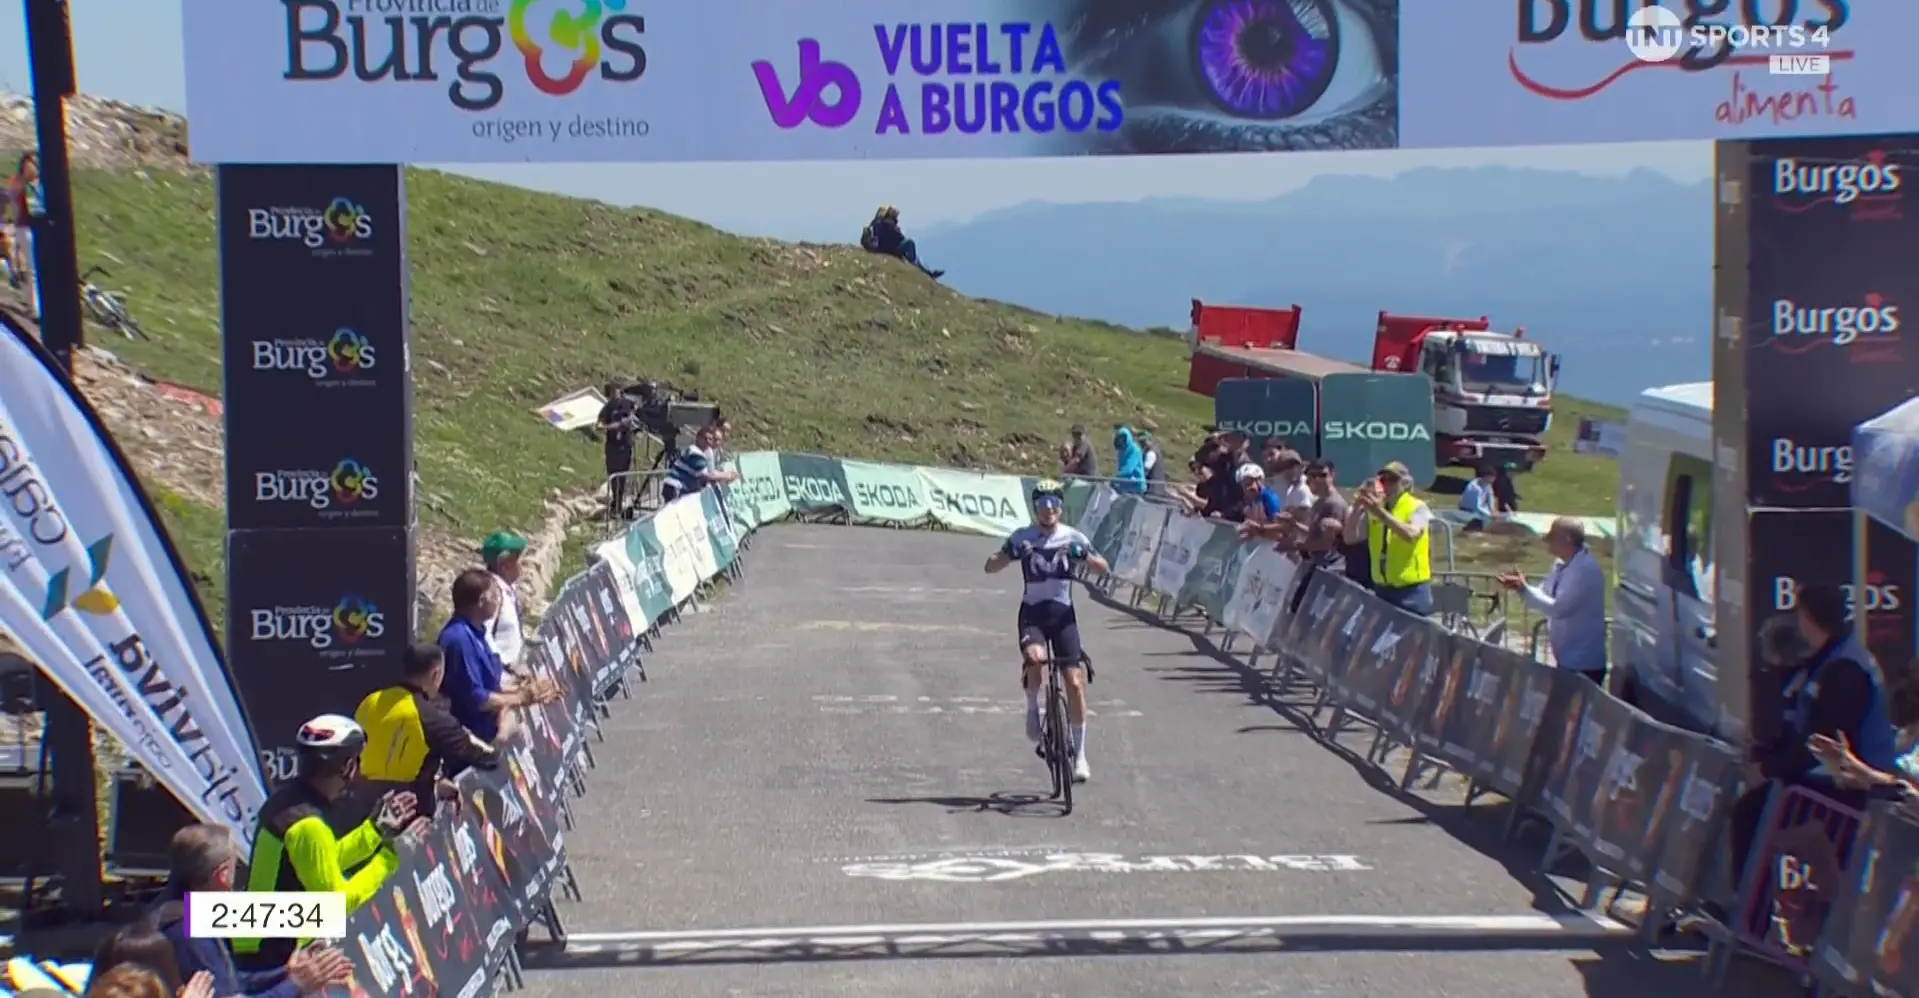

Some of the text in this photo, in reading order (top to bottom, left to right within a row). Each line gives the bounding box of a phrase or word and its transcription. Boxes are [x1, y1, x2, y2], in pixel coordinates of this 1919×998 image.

[282, 0, 646, 111] Burgos
[873, 20, 1066, 76] VUELTA
[875, 80, 1125, 135] A BURGOS
[1715, 71, 1857, 125] alimenta
[472, 113, 650, 143] origen y destino
[1773, 157, 1900, 204] Burgos
[249, 198, 373, 248] Burgos
[1772, 299, 1899, 345] Burgos
[252, 328, 376, 378] Burgos
[255, 459, 379, 509] Burgos
[1772, 438, 1854, 483] Burg
[251, 595, 385, 648] Burgos
